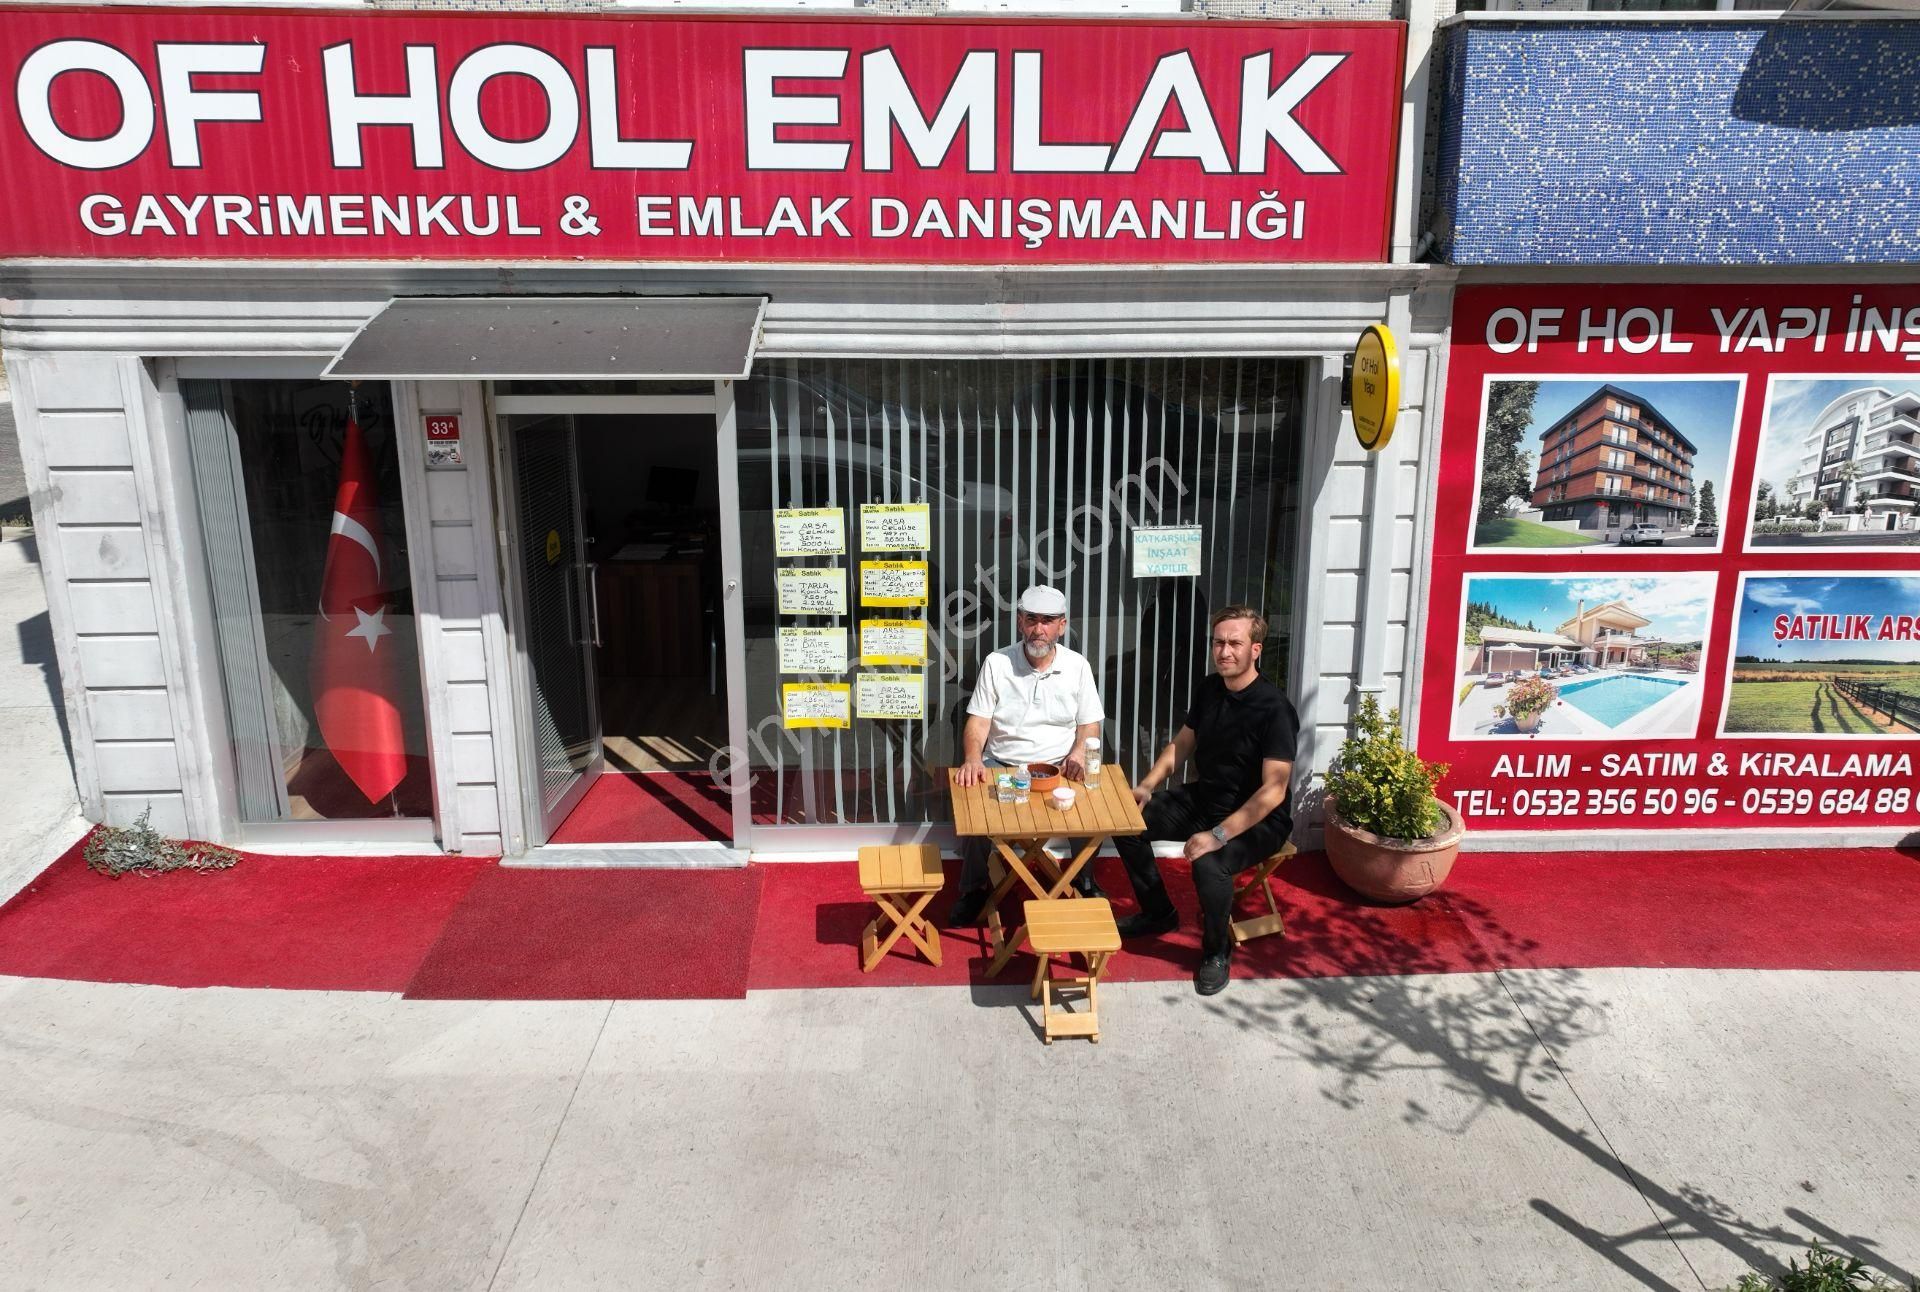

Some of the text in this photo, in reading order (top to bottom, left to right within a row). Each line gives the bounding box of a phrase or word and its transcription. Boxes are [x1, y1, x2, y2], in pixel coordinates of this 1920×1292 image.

[16, 39, 1350, 174] OF HOL EMLAK
[560, 195, 602, 237] &
[638, 196, 851, 238] EMLAK
[871, 191, 1305, 249] DANIŞMANLIĞI
[1485, 307, 1565, 354] OF
[1577, 307, 1694, 354] HOL
[1710, 307, 1831, 353] YAPI
[801, 522, 828, 530] ARSA
[882, 518, 906, 526] ARSA
[1147, 547, 1188, 559] İNŞAAT
[1146, 563, 1188, 574] YAPILIR
[1773, 614, 1874, 641] SATILIK
[1490, 754, 1572, 778] ALIM
[1600, 753, 1698, 777] SATIM
[1706, 752, 1729, 777] &
[1453, 789, 1507, 816] TEL:
[1512, 789, 1581, 816] 0532
[1585, 788, 1637, 815] 356
[1643, 788, 1678, 815] 50
[1683, 788, 1719, 814] 96
[1742, 787, 1814, 815] 0539
[1819, 788, 1871, 815] 684
[1874, 787, 1911, 813] 88
